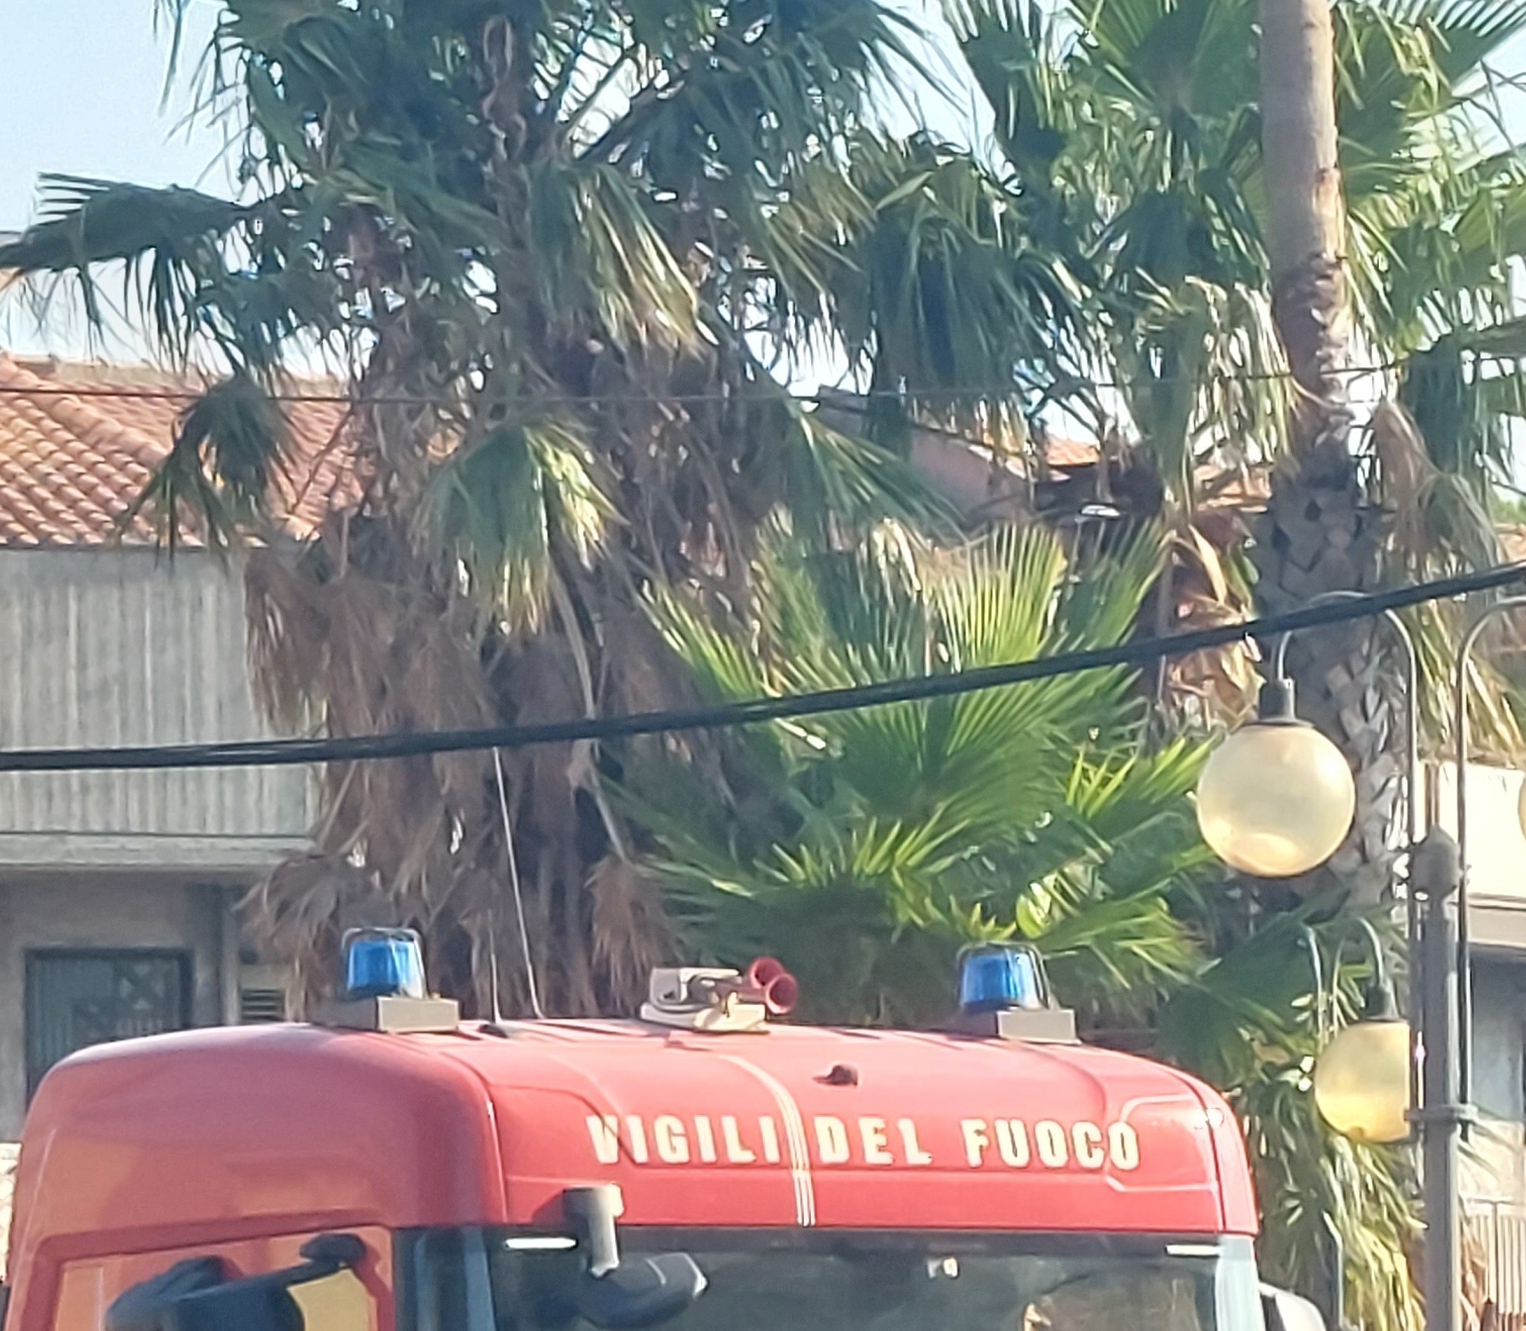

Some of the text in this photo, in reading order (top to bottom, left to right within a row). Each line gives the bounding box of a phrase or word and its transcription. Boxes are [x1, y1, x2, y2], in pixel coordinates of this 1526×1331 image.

[586, 1113, 1141, 1171] VIGILI DEL FUOCO
